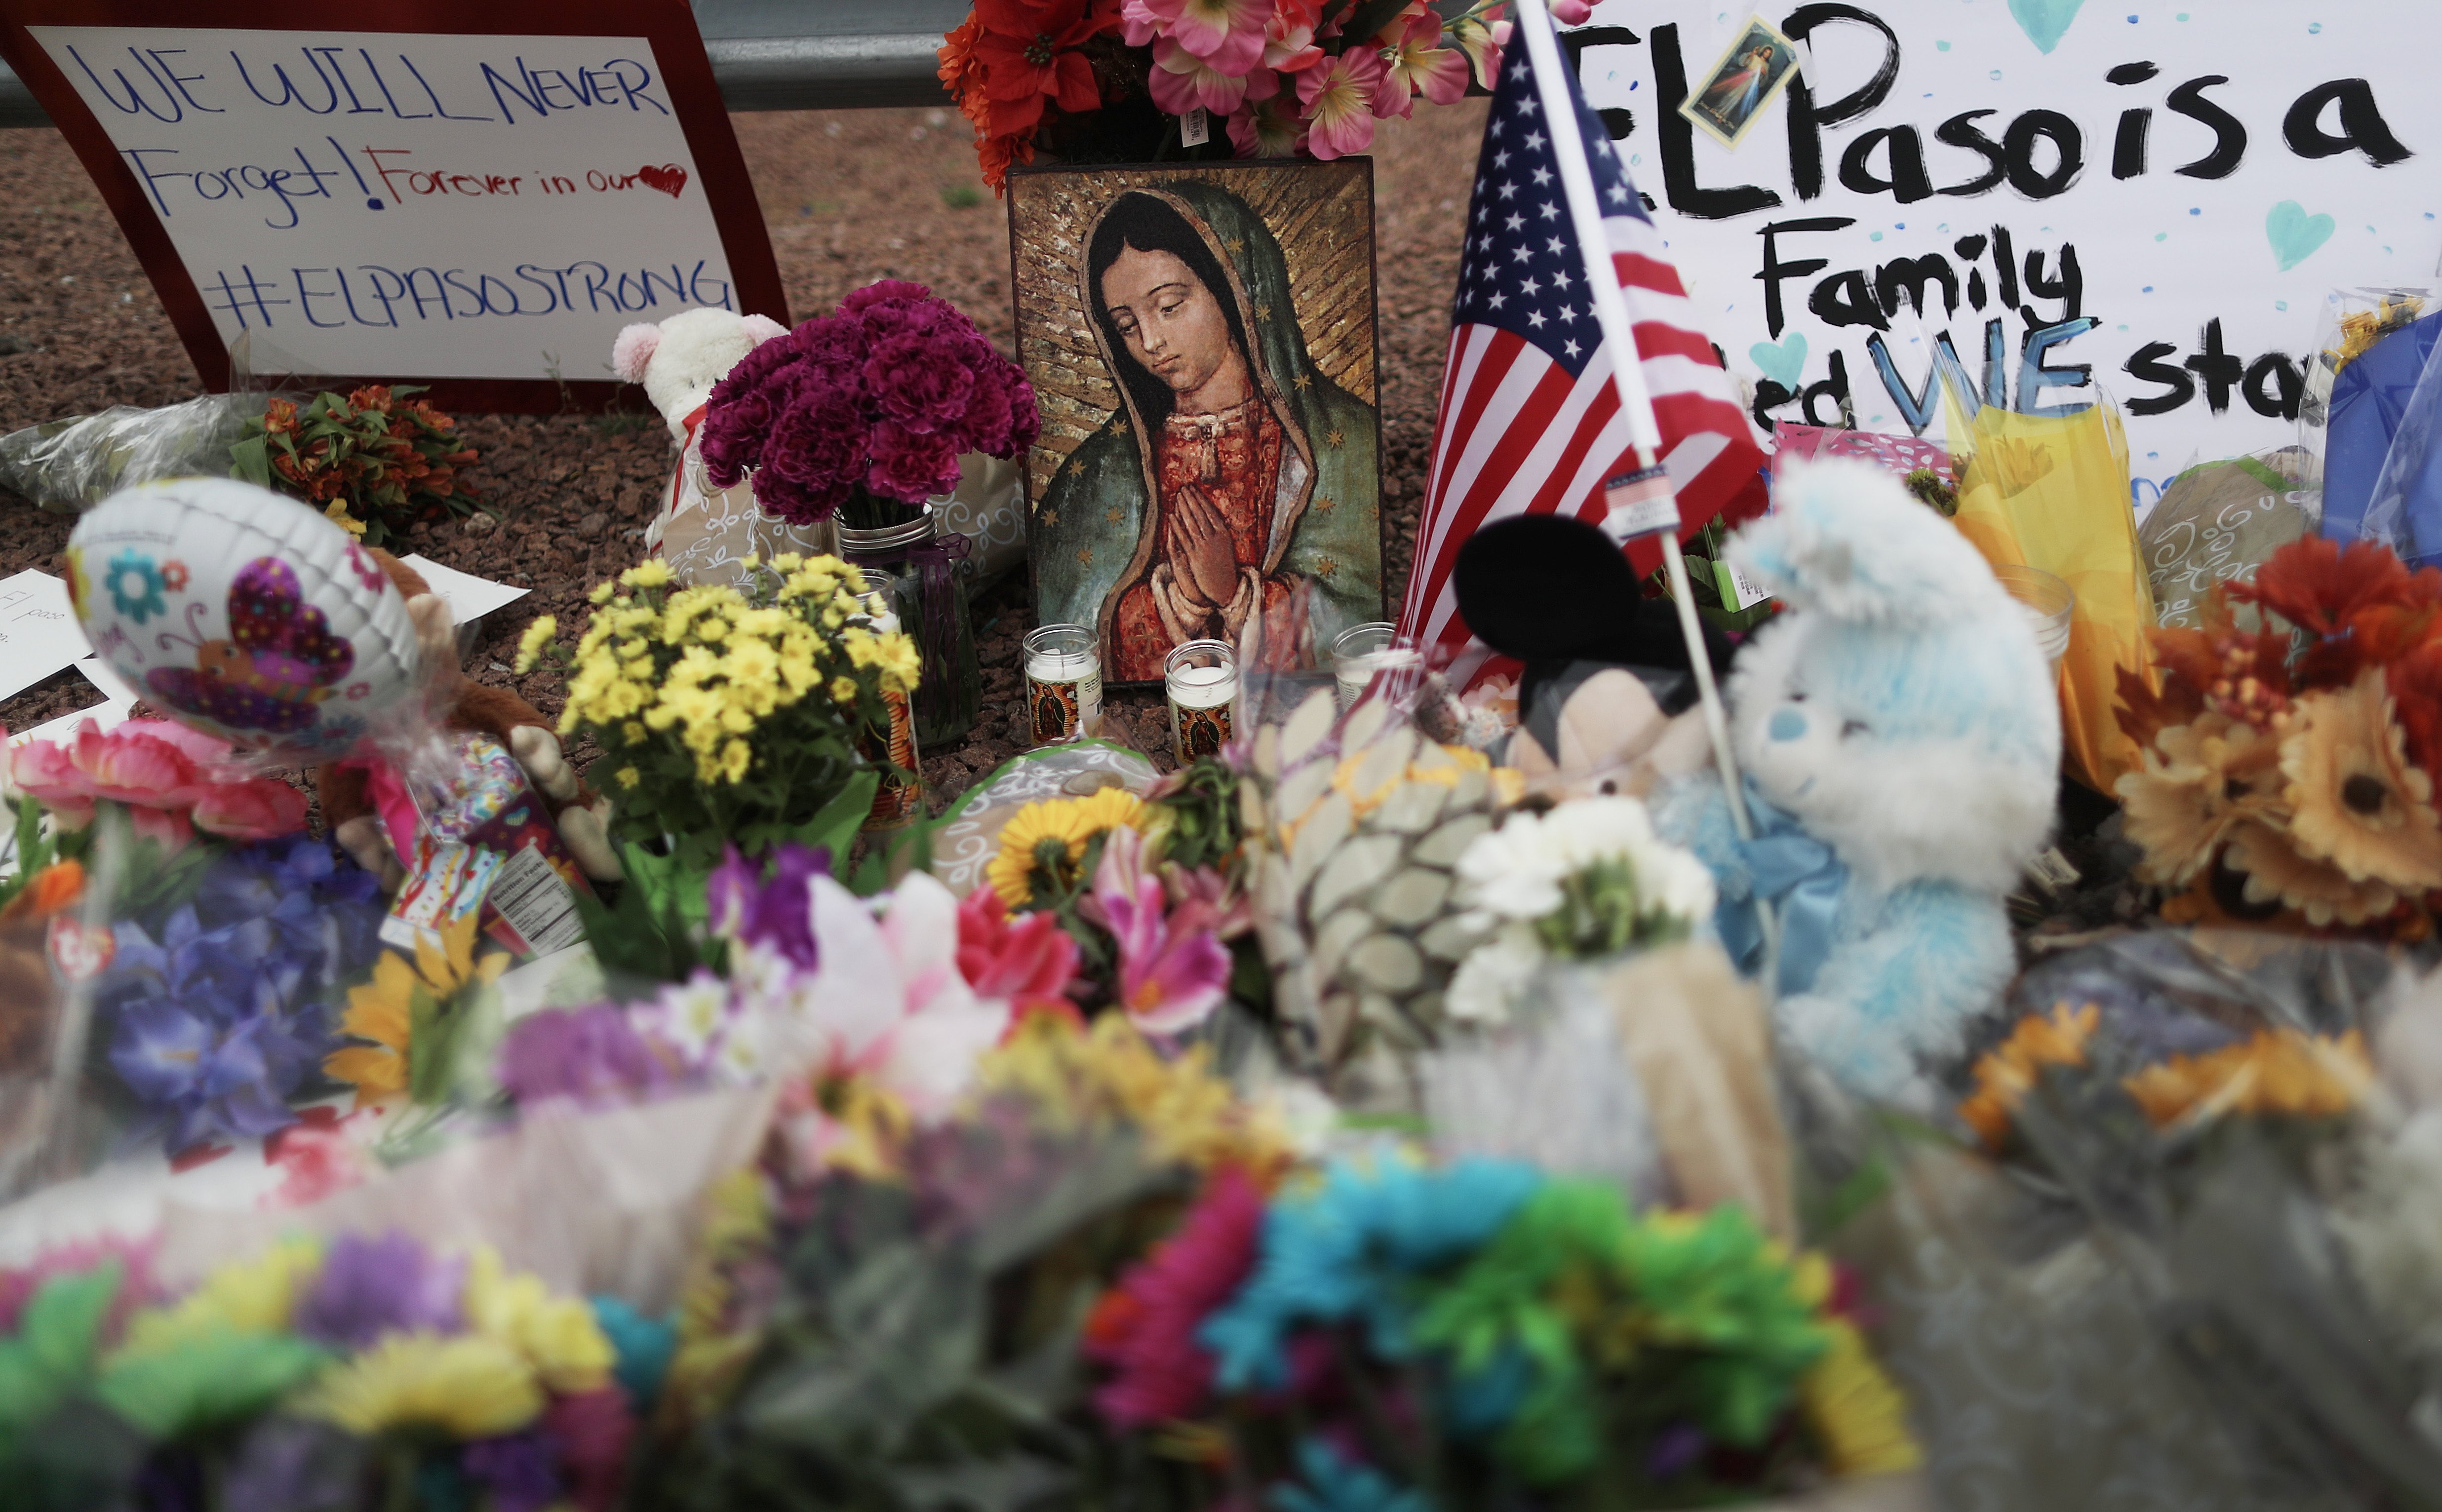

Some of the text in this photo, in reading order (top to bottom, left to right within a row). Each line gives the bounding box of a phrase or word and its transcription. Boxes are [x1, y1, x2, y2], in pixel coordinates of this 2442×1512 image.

[66, 44, 669, 124] WE WILL NEVER
[1781, 1, 2085, 203] Paso
[2103, 61, 2248, 181] is
[2282, 78, 2416, 169] a
[118, 136, 385, 229] Forget!
[361, 146, 522, 204] Forever
[534, 170, 576, 194] in
[203, 260, 732, 328] #ELPASOSTRONG
[1754, 217, 2083, 341] Family
[1866, 316, 2102, 437] WE
